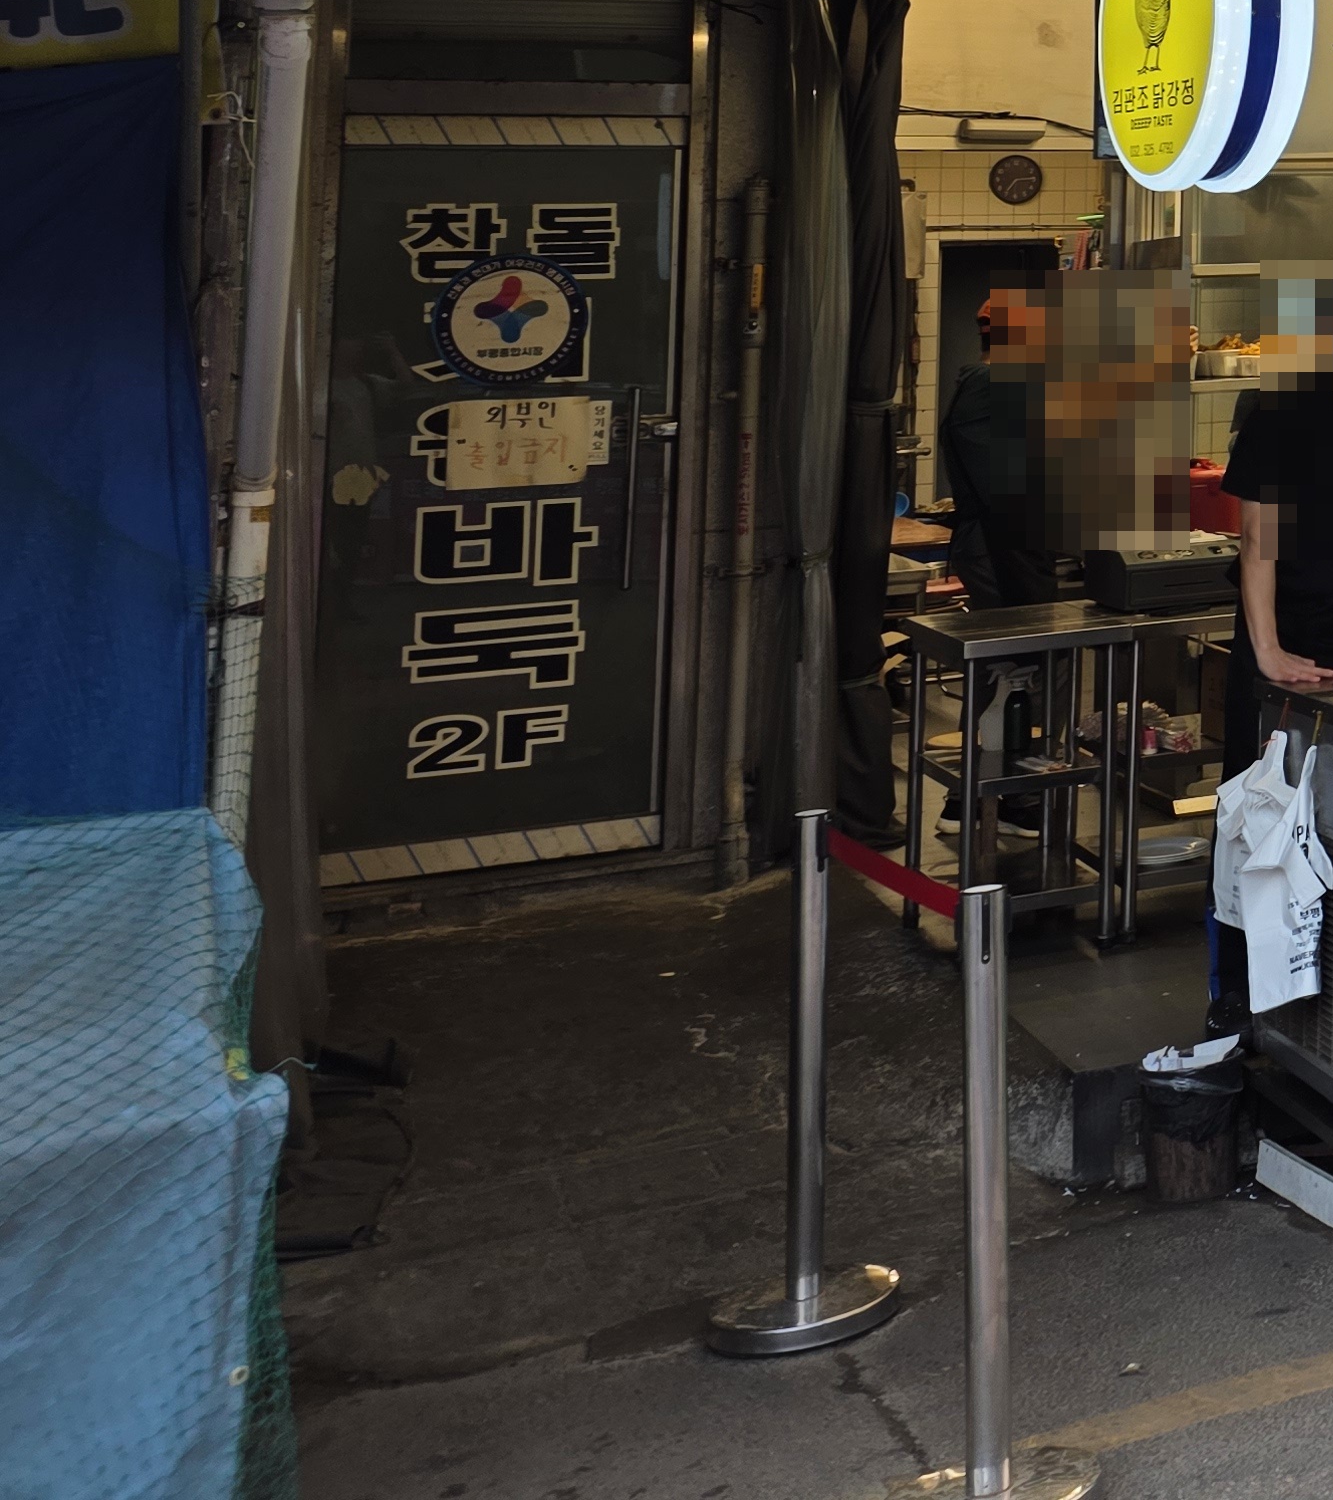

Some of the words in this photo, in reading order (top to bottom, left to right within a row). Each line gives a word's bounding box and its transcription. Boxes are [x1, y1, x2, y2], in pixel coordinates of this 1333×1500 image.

[1113, 85, 1149, 114] 김판조
[1153, 78, 1194, 109] 닭강정
[485, 401, 556, 430] 외부인
[406, 704, 569, 779] 2F
